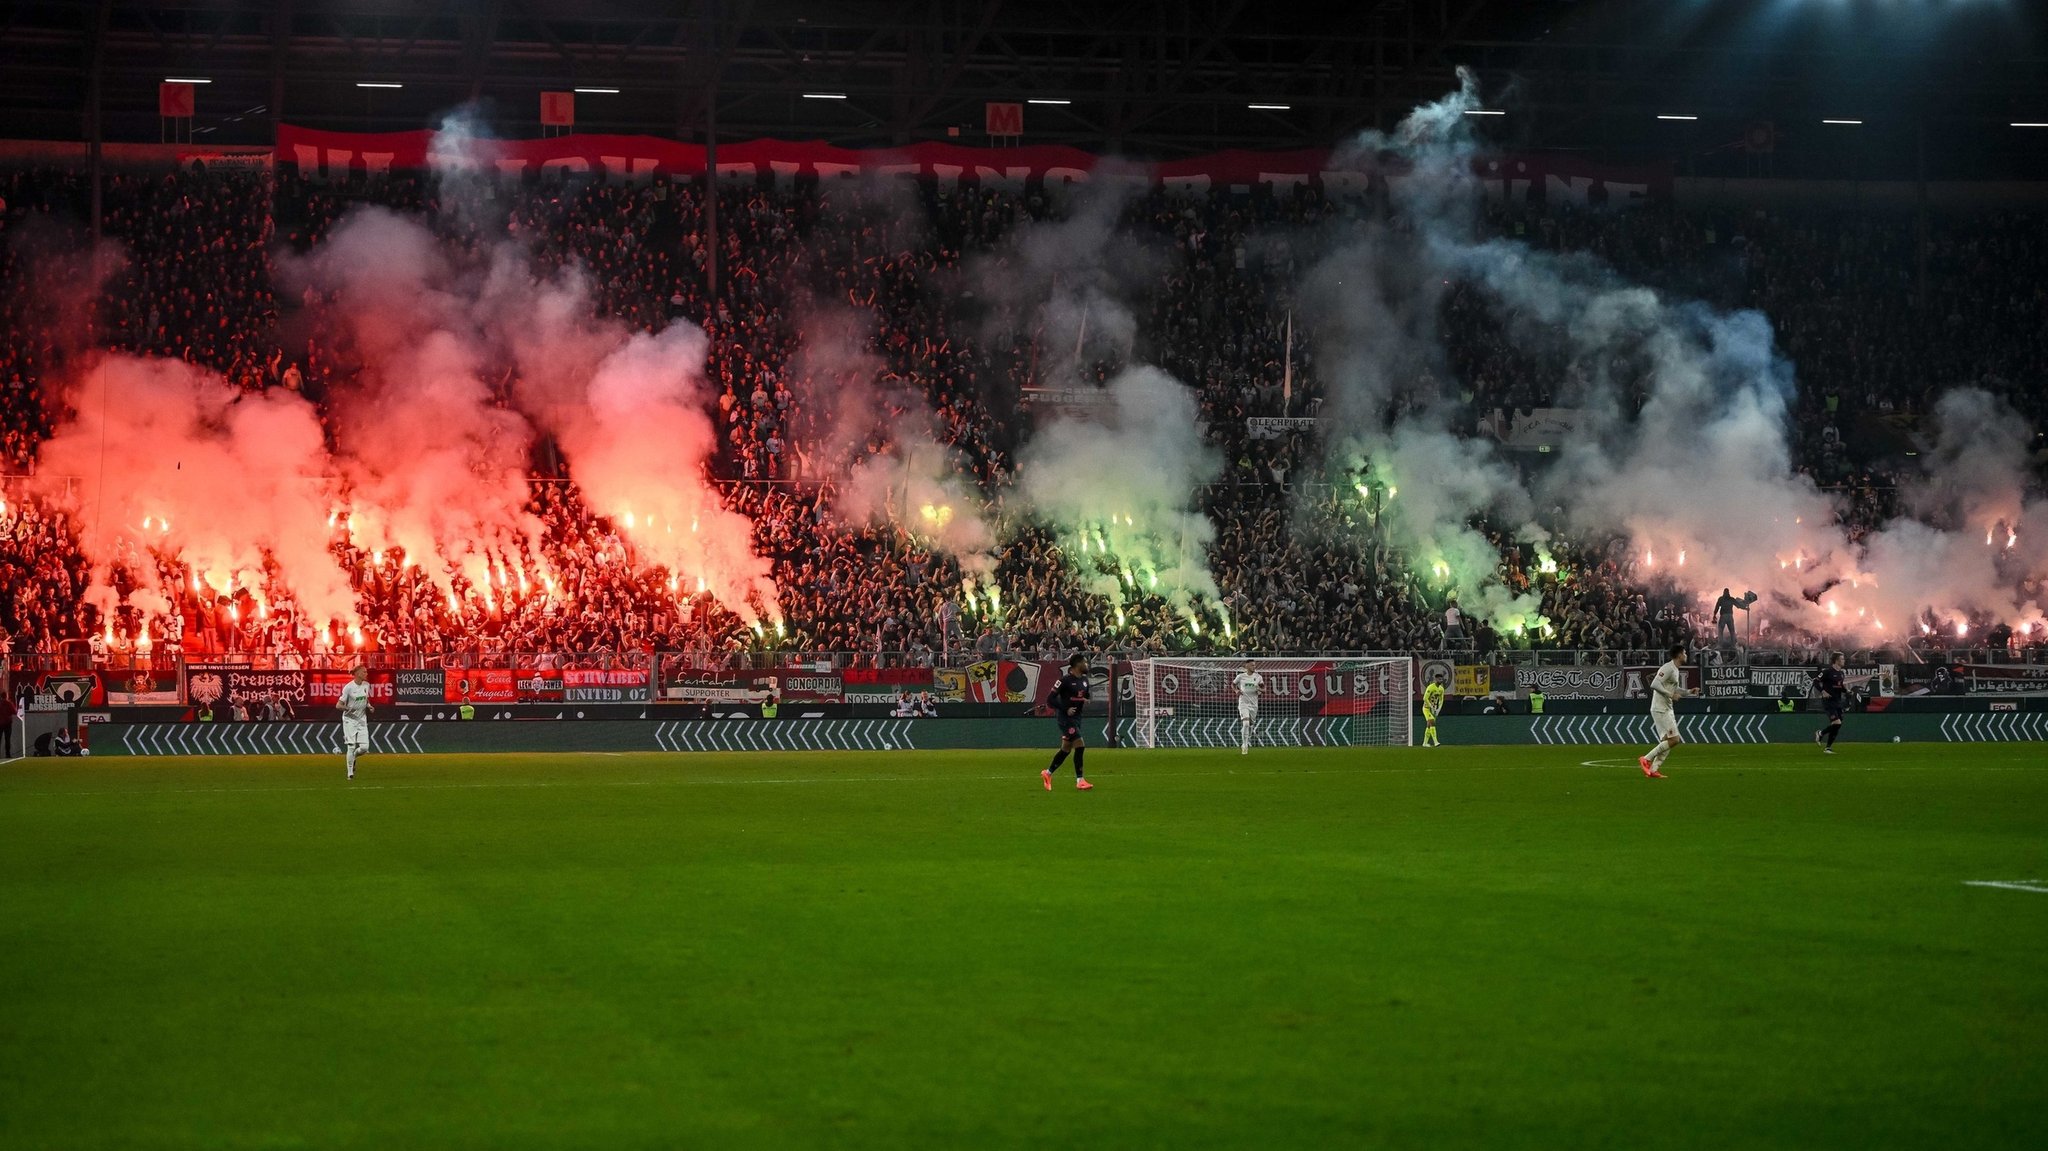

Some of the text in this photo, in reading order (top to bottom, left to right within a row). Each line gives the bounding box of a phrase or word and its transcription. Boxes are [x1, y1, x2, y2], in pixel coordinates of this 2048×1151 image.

[164, 84, 190, 114] K
[549, 94, 567, 120] L
[989, 105, 1020, 132] M
[565, 671, 646, 684] SCHWABEN
[1711, 667, 1746, 679] BLOCK
[1752, 671, 1801, 685] AUGSBURG
[543, 680, 563, 690] POWER
[787, 677, 841, 690] CONCORDIA
[1518, 669, 1621, 692] WEST-OF
[310, 683, 394, 697] DISSNTS
[474, 687, 514, 700] Augusta
[565, 688, 647, 700] UNITED 07
[685, 688, 730, 698] SUPPORTER
[1709, 685, 1748, 697] BRIGADE
[34, 694, 57, 704] FREIE
[82, 715, 105, 723] FCA
